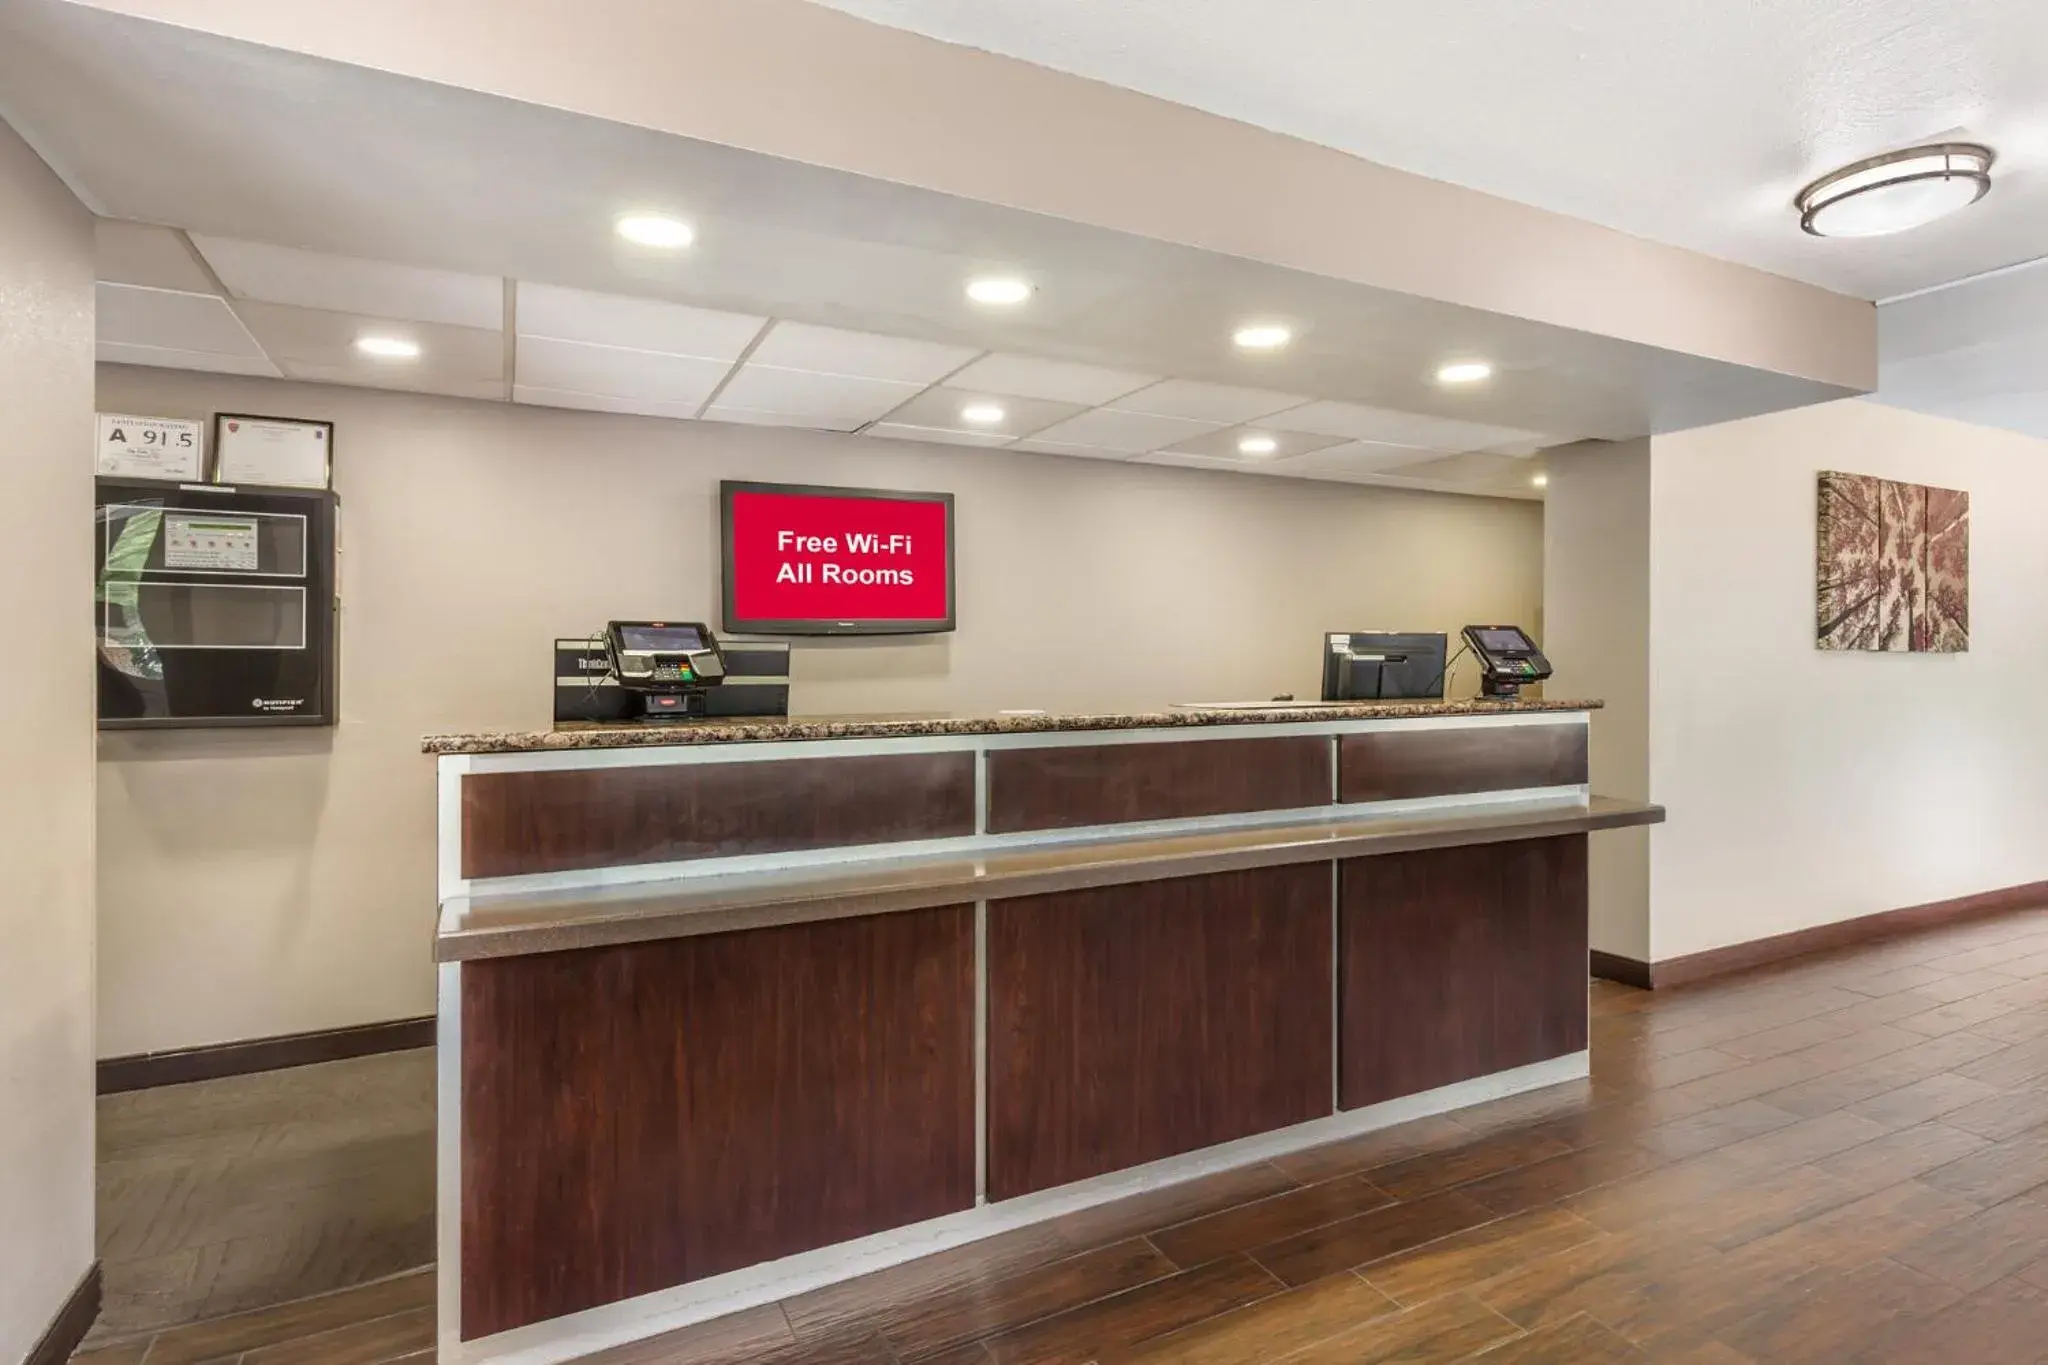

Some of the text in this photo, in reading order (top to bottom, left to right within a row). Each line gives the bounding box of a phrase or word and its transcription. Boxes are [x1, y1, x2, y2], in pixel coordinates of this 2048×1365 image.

[109, 428, 127, 442] A
[778, 530, 912, 555] Free Wi-Fi
[776, 562, 914, 585] All Rooms
